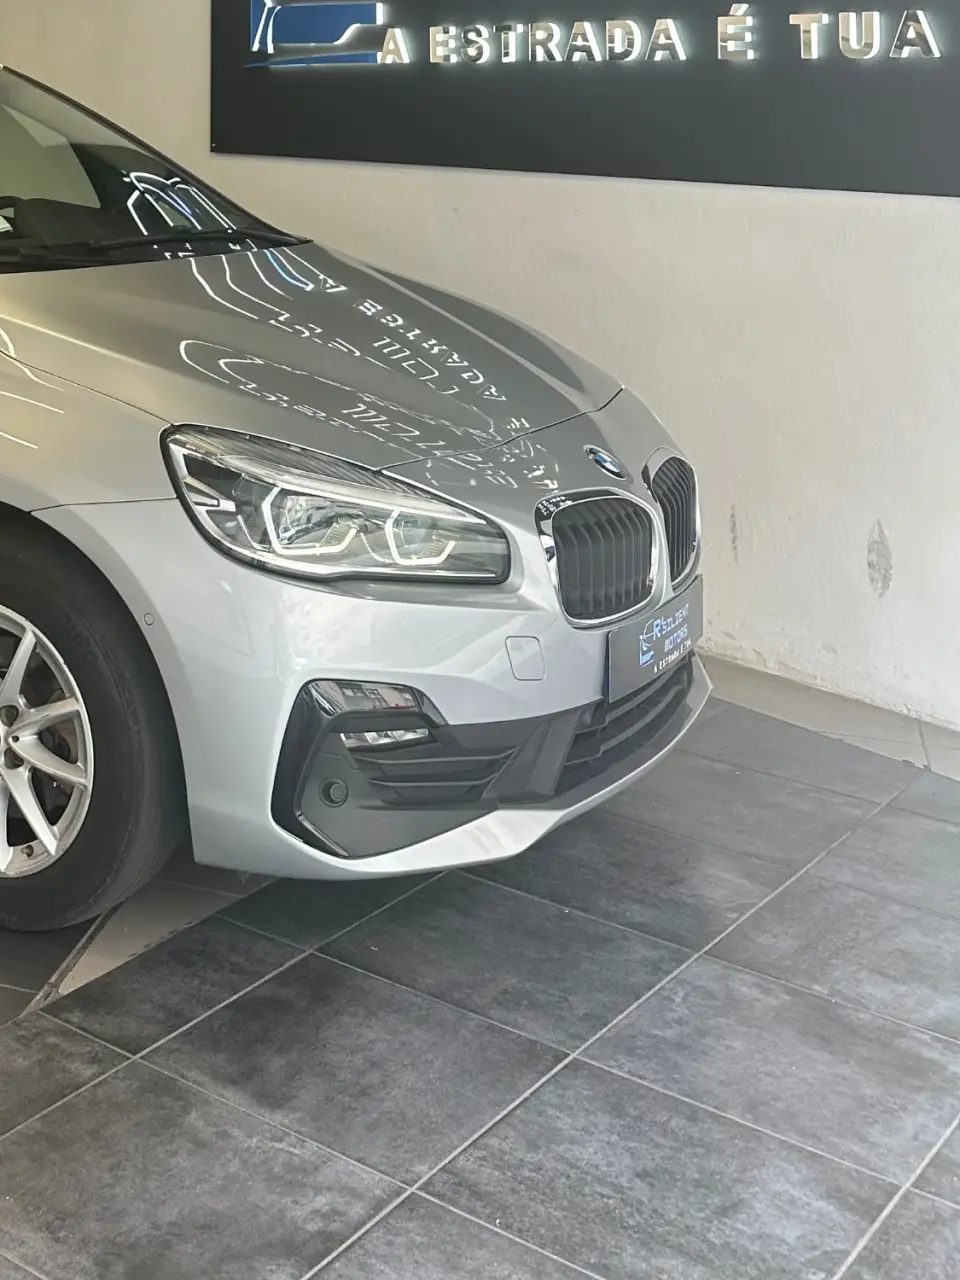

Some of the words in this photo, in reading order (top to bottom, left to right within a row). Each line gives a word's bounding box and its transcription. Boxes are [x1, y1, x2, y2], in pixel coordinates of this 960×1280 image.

[378, 27, 410, 64] A
[429, 19, 687, 64] ESTRADA
[718, 4, 756, 61] É
[789, 10, 942, 61] TUA
